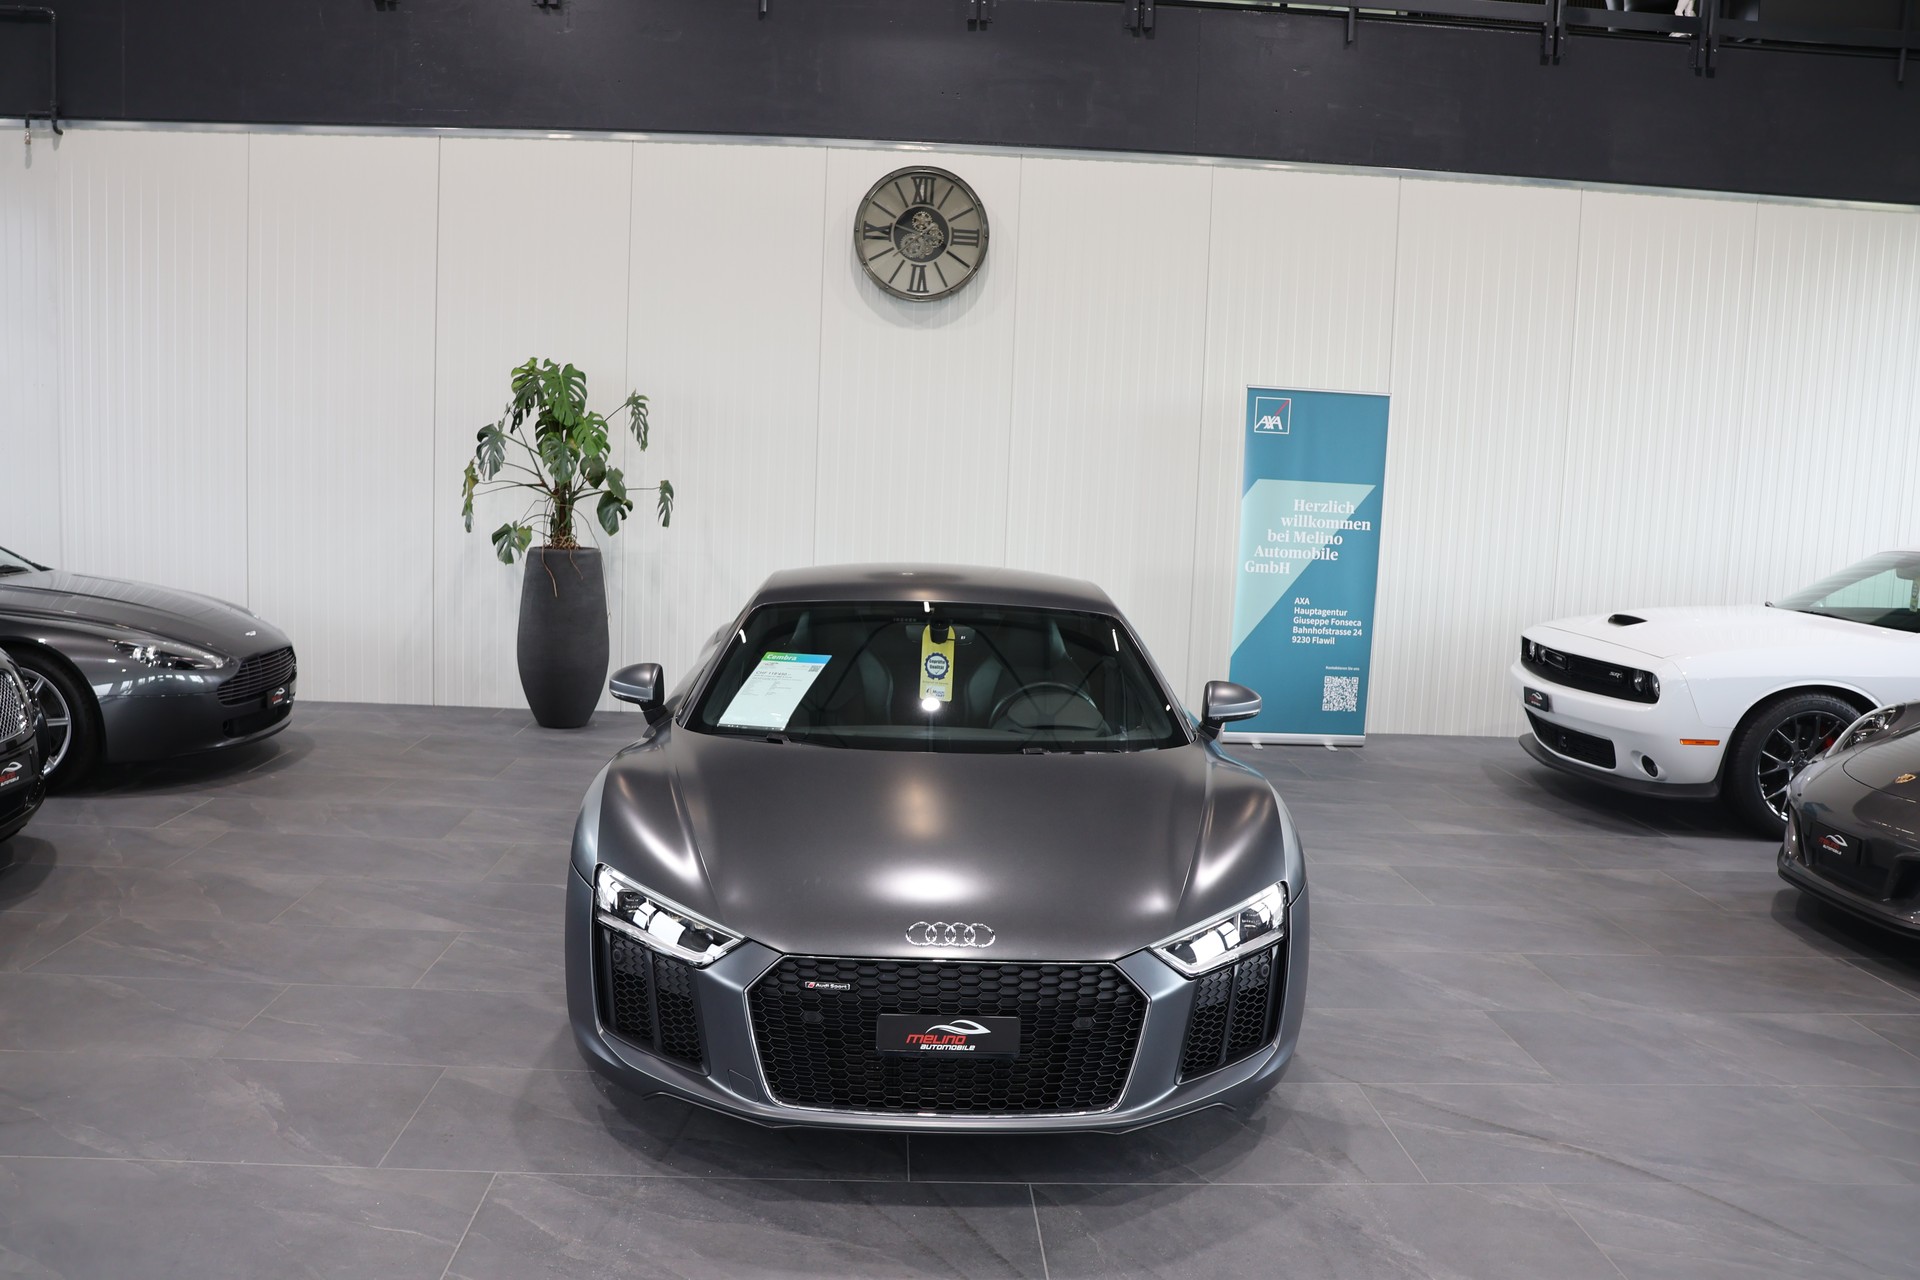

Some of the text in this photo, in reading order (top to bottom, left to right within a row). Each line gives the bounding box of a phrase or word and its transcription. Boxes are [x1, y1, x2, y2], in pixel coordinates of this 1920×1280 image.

[1255, 415, 1283, 430] AXA
[1293, 499, 1355, 514] Herzlich
[1281, 514, 1371, 531] willkommen
[1267, 529, 1343, 545] bei Melino
[1254, 545, 1339, 561] Automobile
[1244, 560, 1291, 574] GmbH
[1294, 597, 1310, 605] AXA
[1293, 606, 1348, 617] Hauptagentur
[1293, 616, 1362, 627] Giuseppe Fonseca
[1292, 625, 1363, 636] Bahnhofstrasse 24
[1291, 636, 1335, 645] 9230 Flawil
[766, 653, 797, 661] Cembra
[905, 1033, 967, 1045] MELINO
[920, 1043, 976, 1051] AUTOMOBILE
